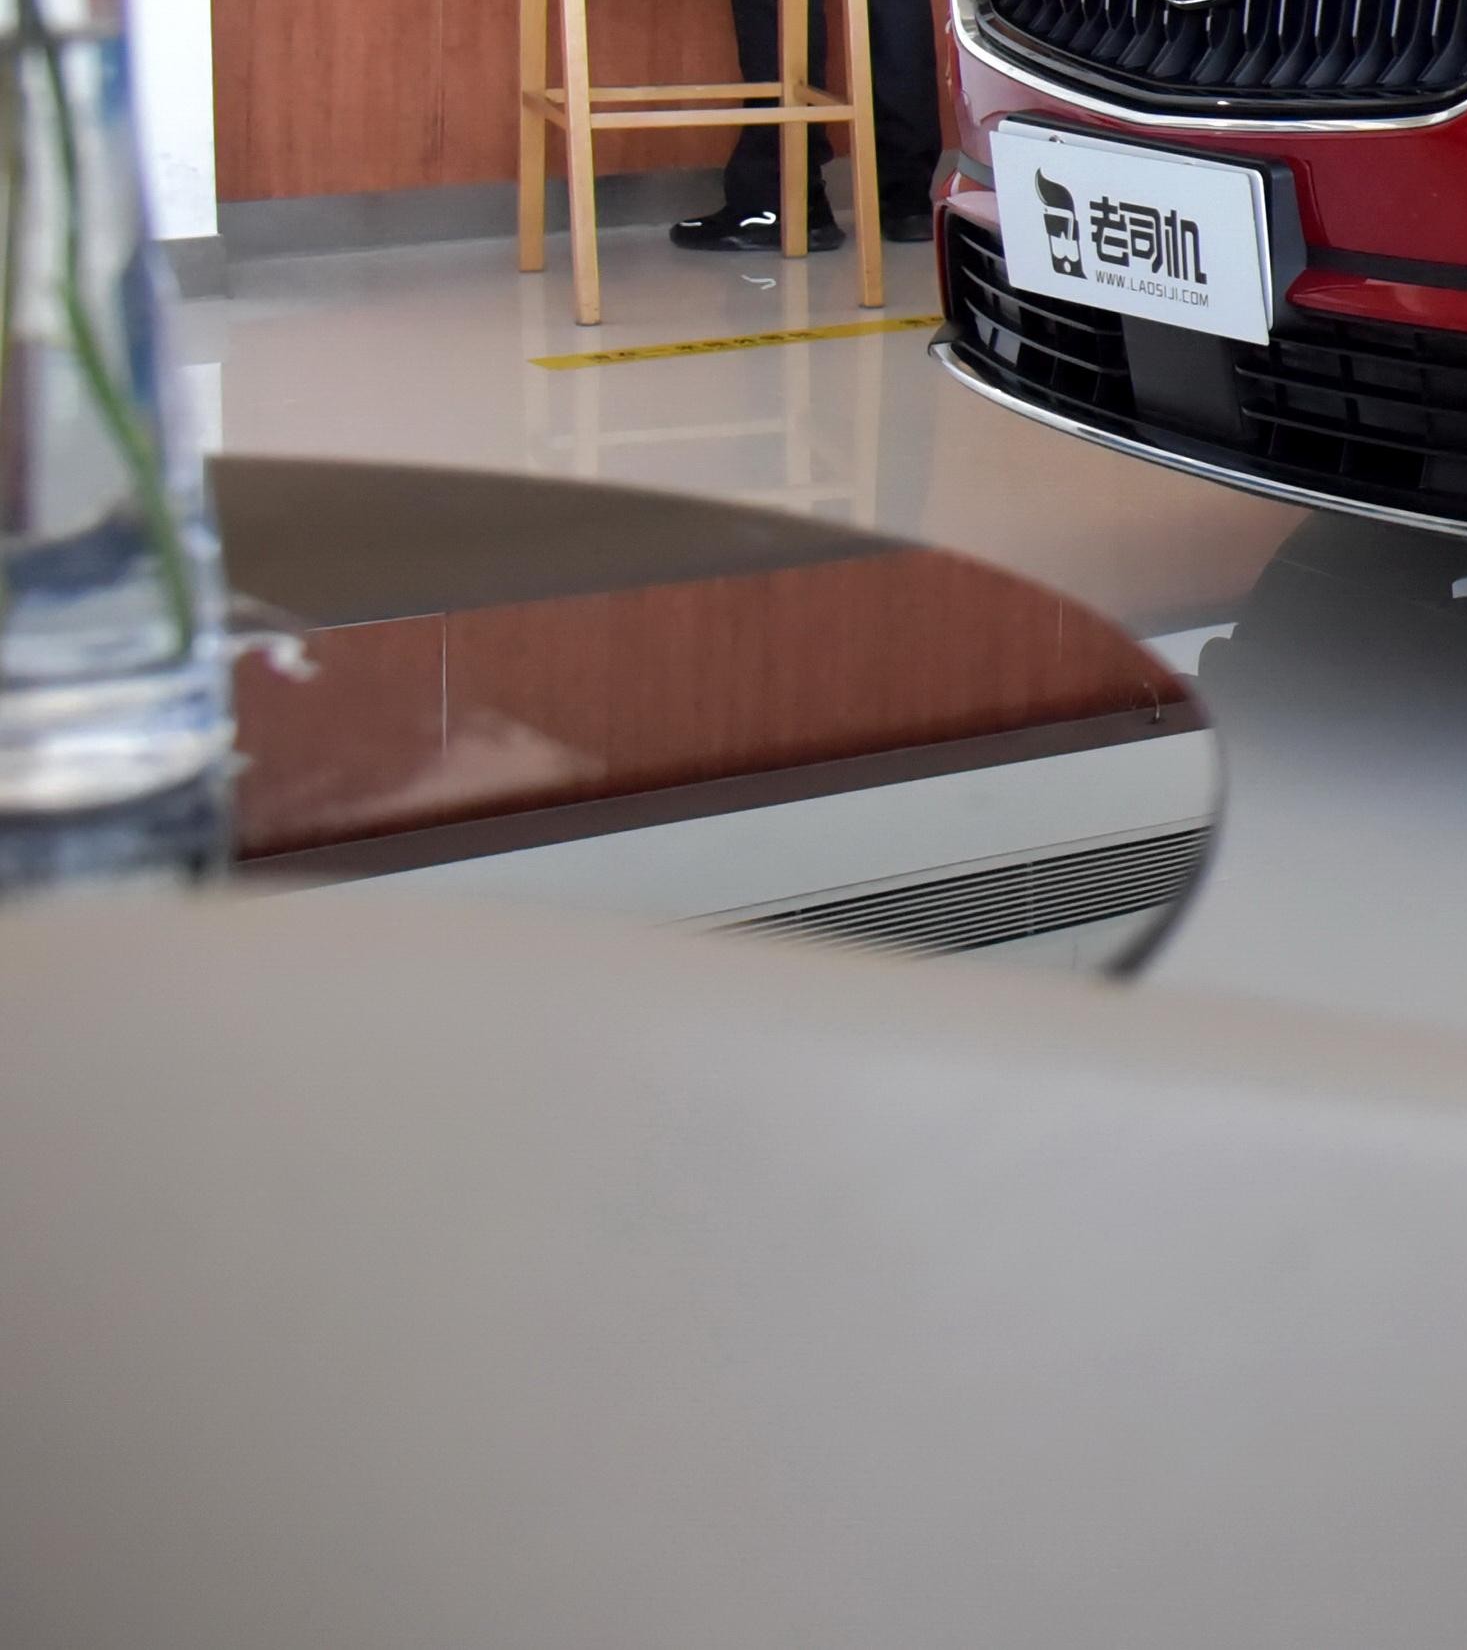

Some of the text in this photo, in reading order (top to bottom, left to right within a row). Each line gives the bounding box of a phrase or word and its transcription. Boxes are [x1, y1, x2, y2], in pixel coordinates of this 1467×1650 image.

[1089, 195, 1207, 285] 老司机
[1095, 269, 1209, 307] WWW.LAOSIJI.COM
